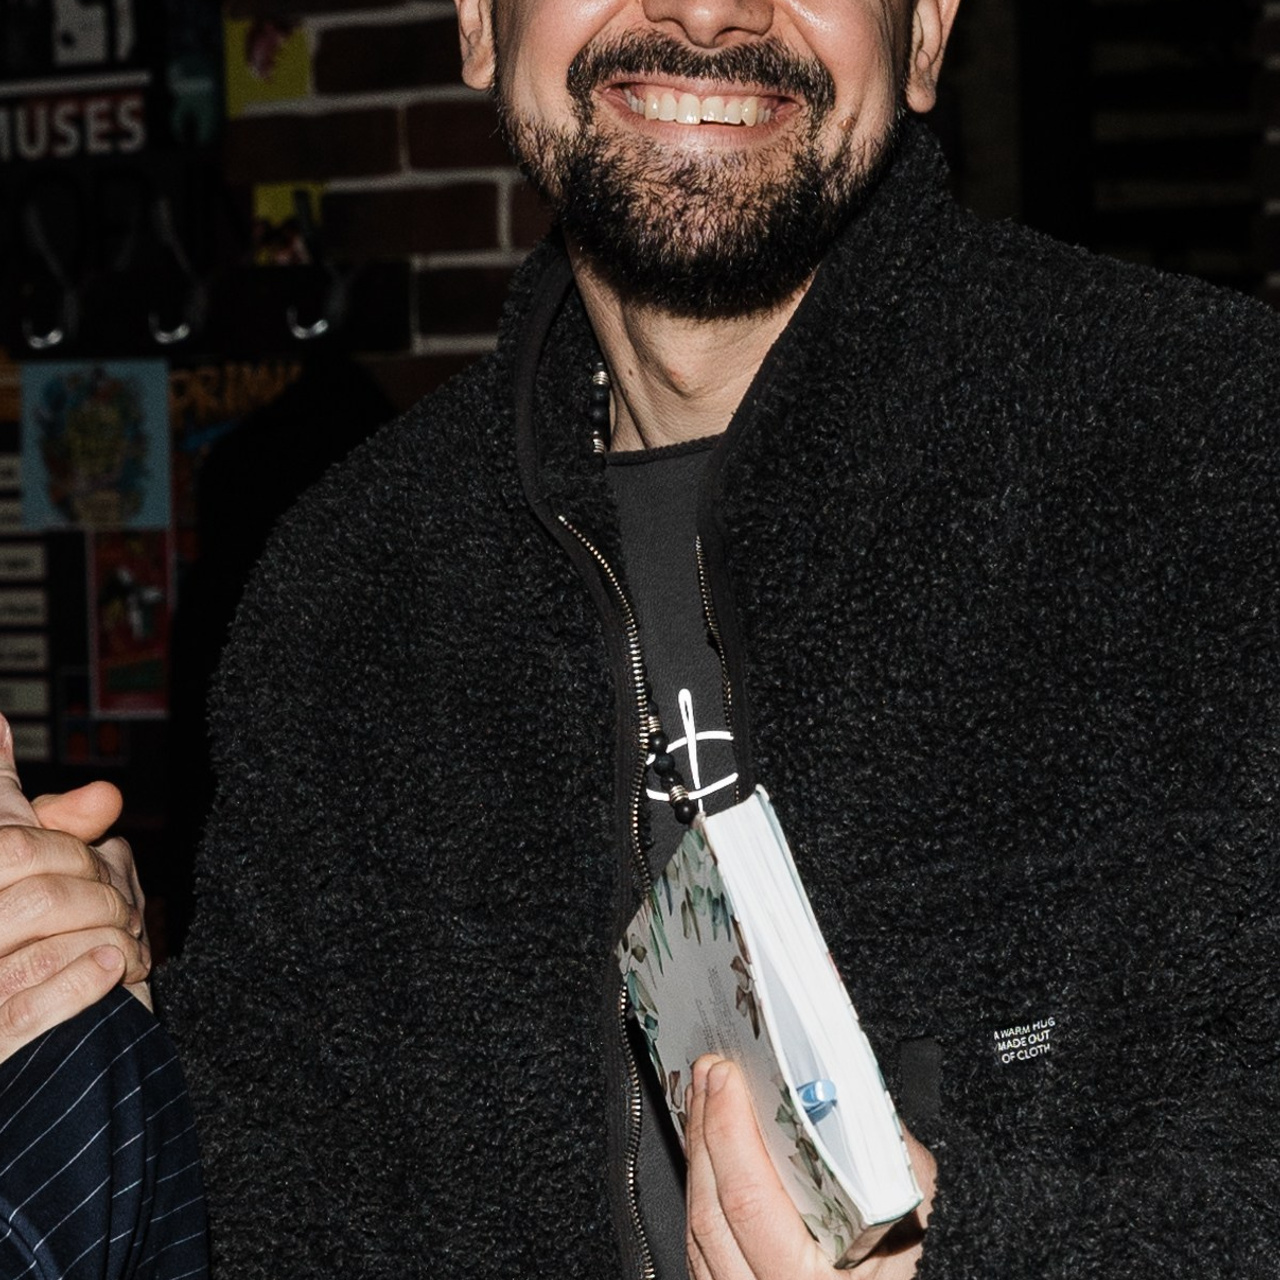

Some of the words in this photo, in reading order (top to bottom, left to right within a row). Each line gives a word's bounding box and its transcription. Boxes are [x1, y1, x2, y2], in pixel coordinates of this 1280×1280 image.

[1000, 1025, 1031, 1038] WARM
[1032, 1017, 1056, 1031] HUG
[997, 1037, 1027, 1051] MADE
[1027, 1029, 1051, 1044] OUT
[1001, 1051, 1016, 1064] OF
[1016, 1044, 1050, 1061] CLOTH
